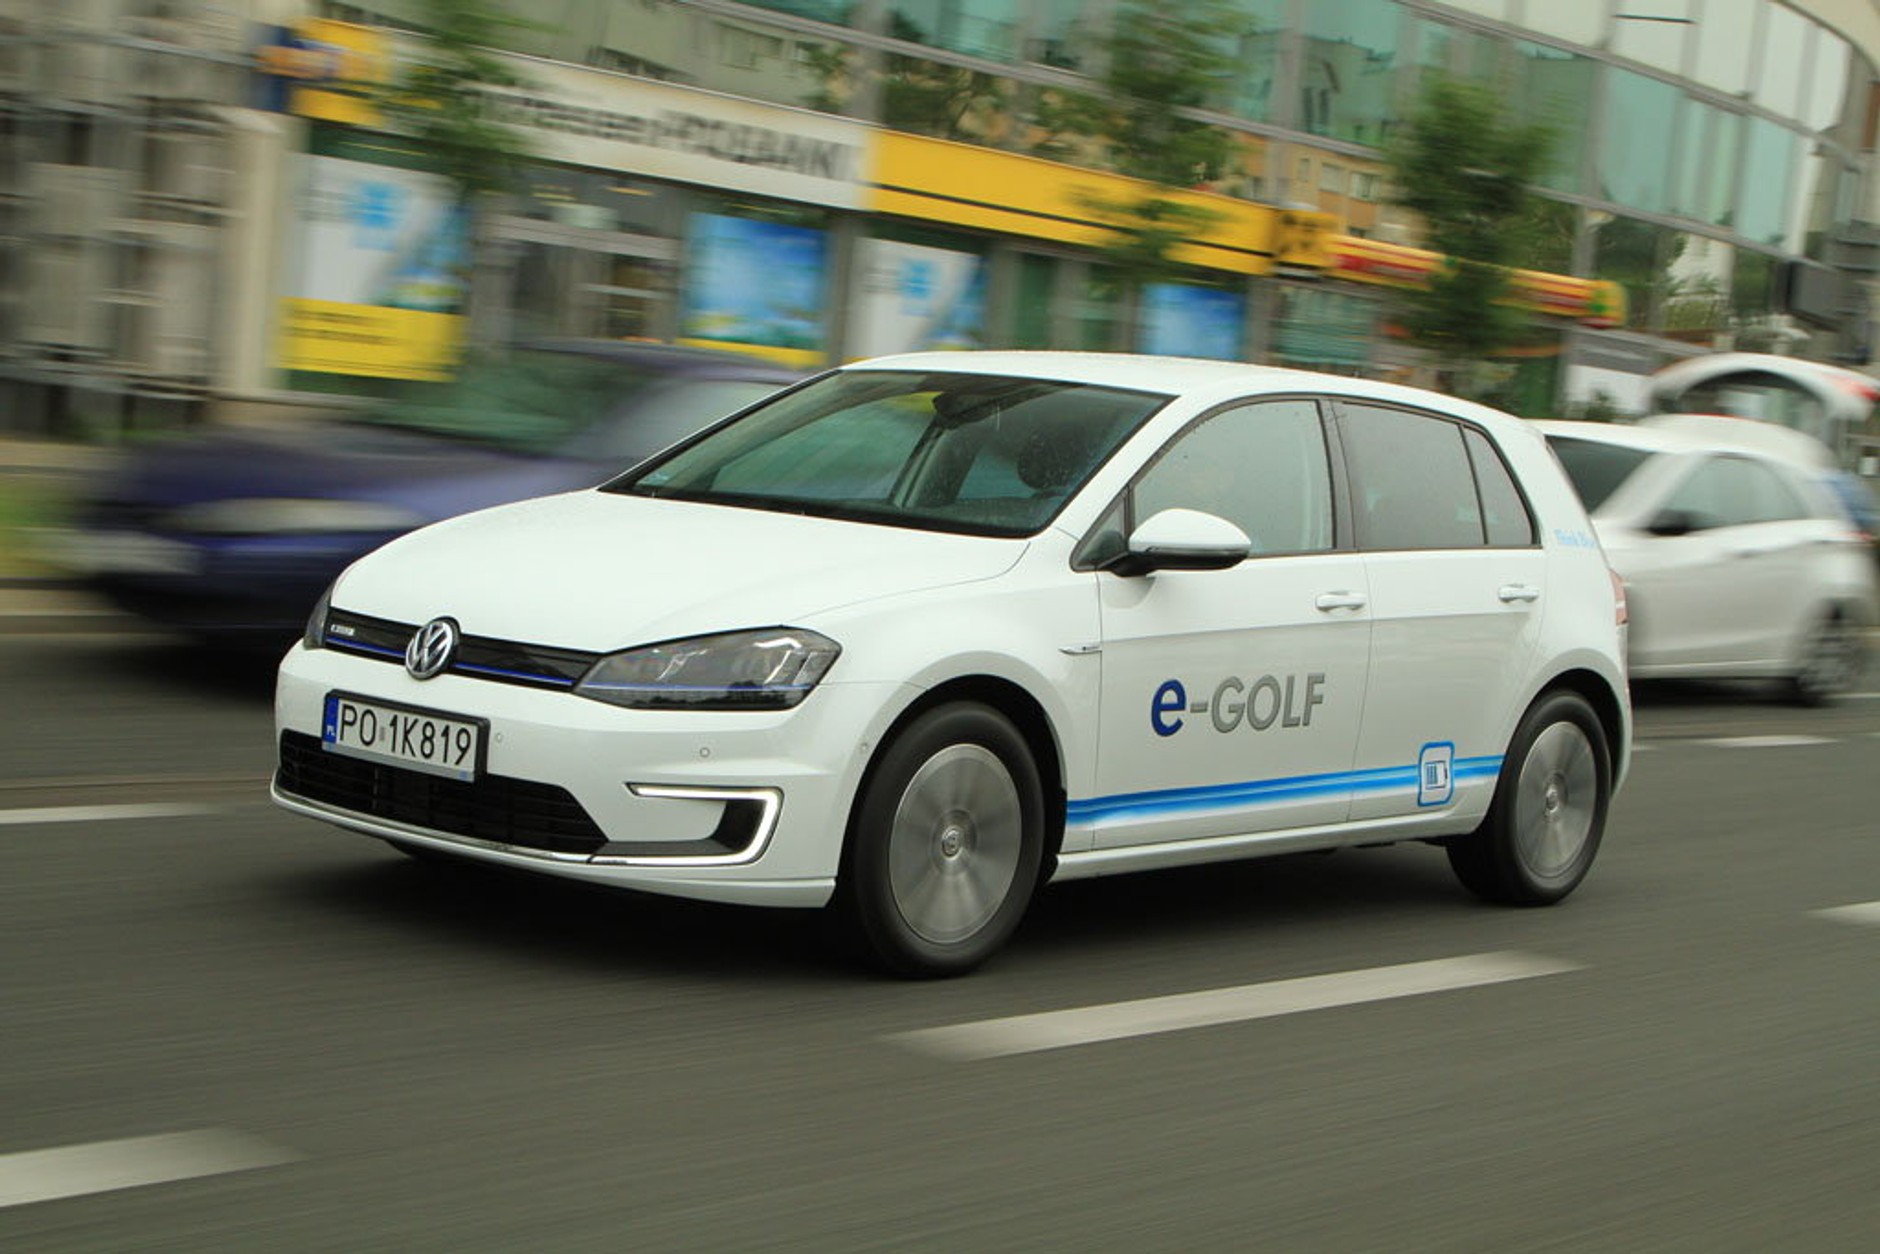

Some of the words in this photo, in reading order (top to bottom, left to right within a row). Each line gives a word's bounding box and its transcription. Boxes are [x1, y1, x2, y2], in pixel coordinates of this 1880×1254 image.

[339, 703, 377, 747] PO
[389, 713, 472, 766] 1K819
[1151, 672, 1325, 738] e-GOLF
